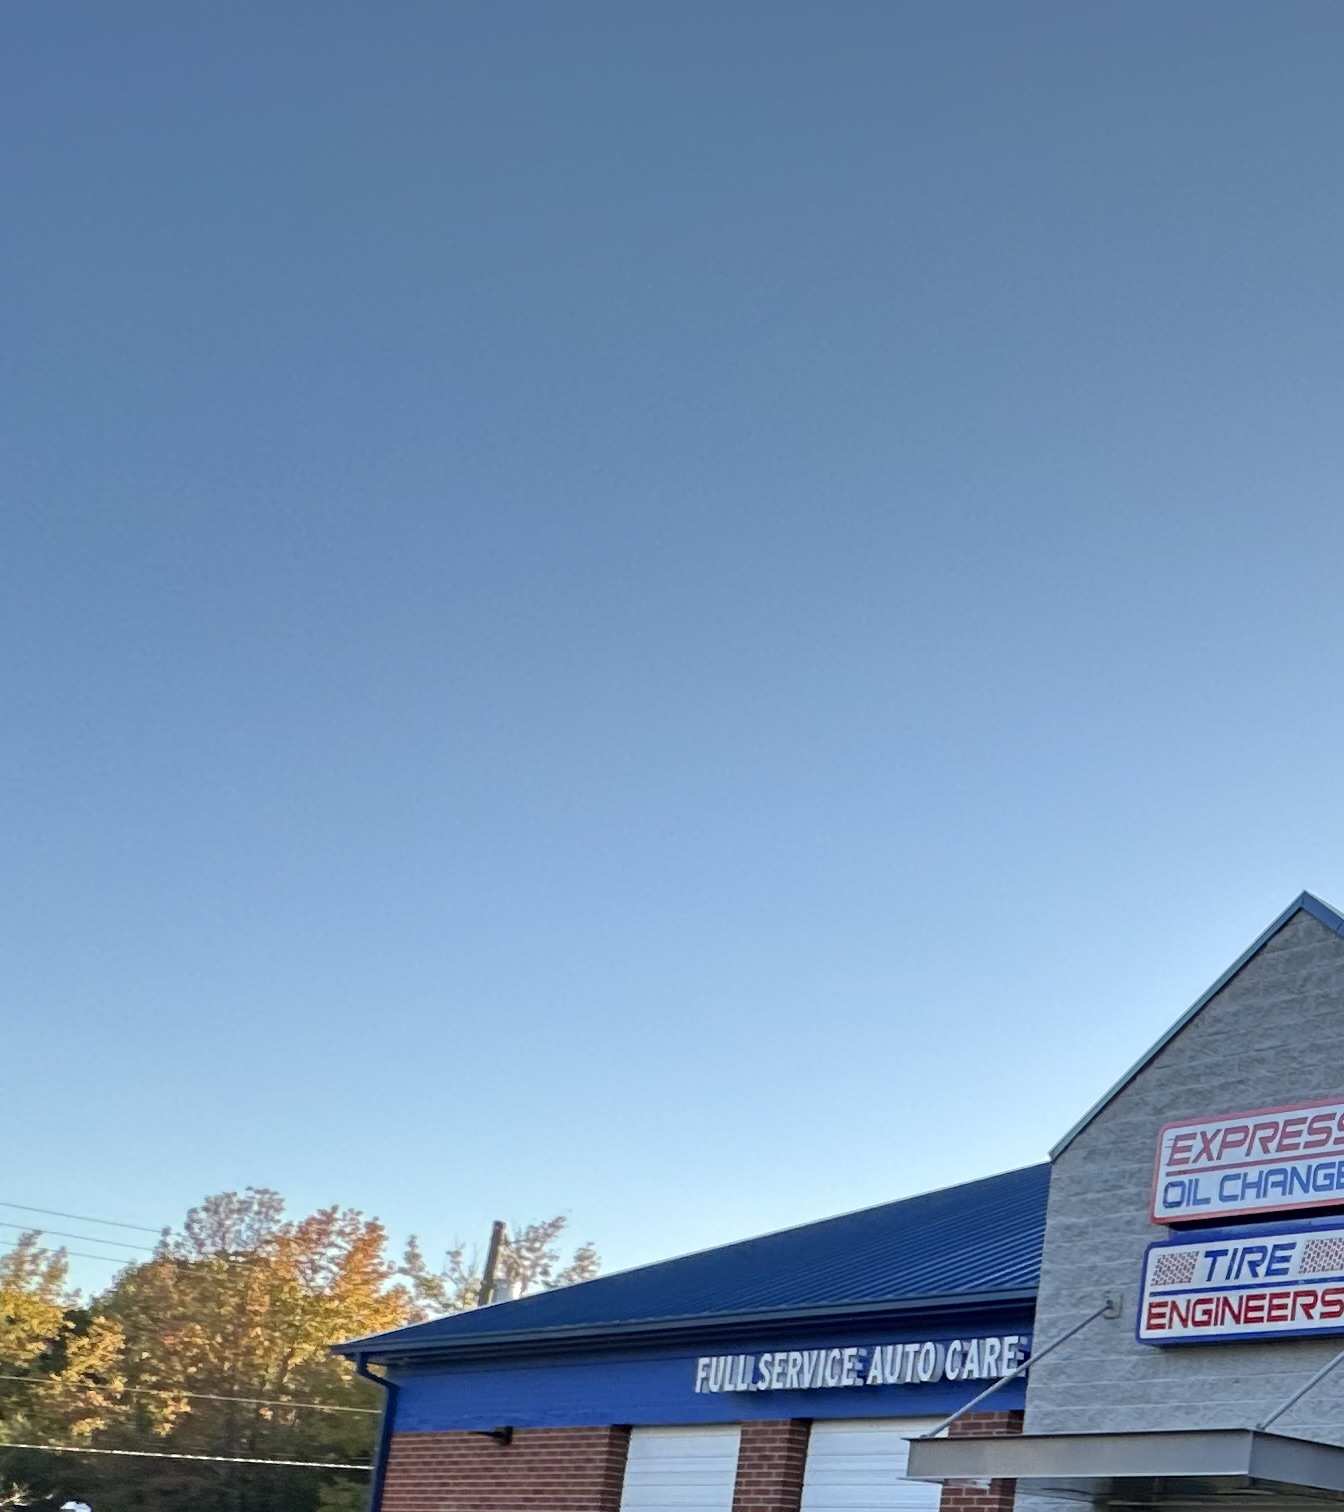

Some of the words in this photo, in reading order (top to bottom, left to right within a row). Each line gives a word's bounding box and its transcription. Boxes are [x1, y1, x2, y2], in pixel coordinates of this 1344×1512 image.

[1163, 1177, 1211, 1209] OIL
[1204, 1241, 1298, 1282] TIRE
[695, 1354, 756, 1393] FULL
[757, 1346, 865, 1390] SERVICE
[866, 1341, 944, 1385] AUTO
[945, 1335, 1025, 1380] CARE
